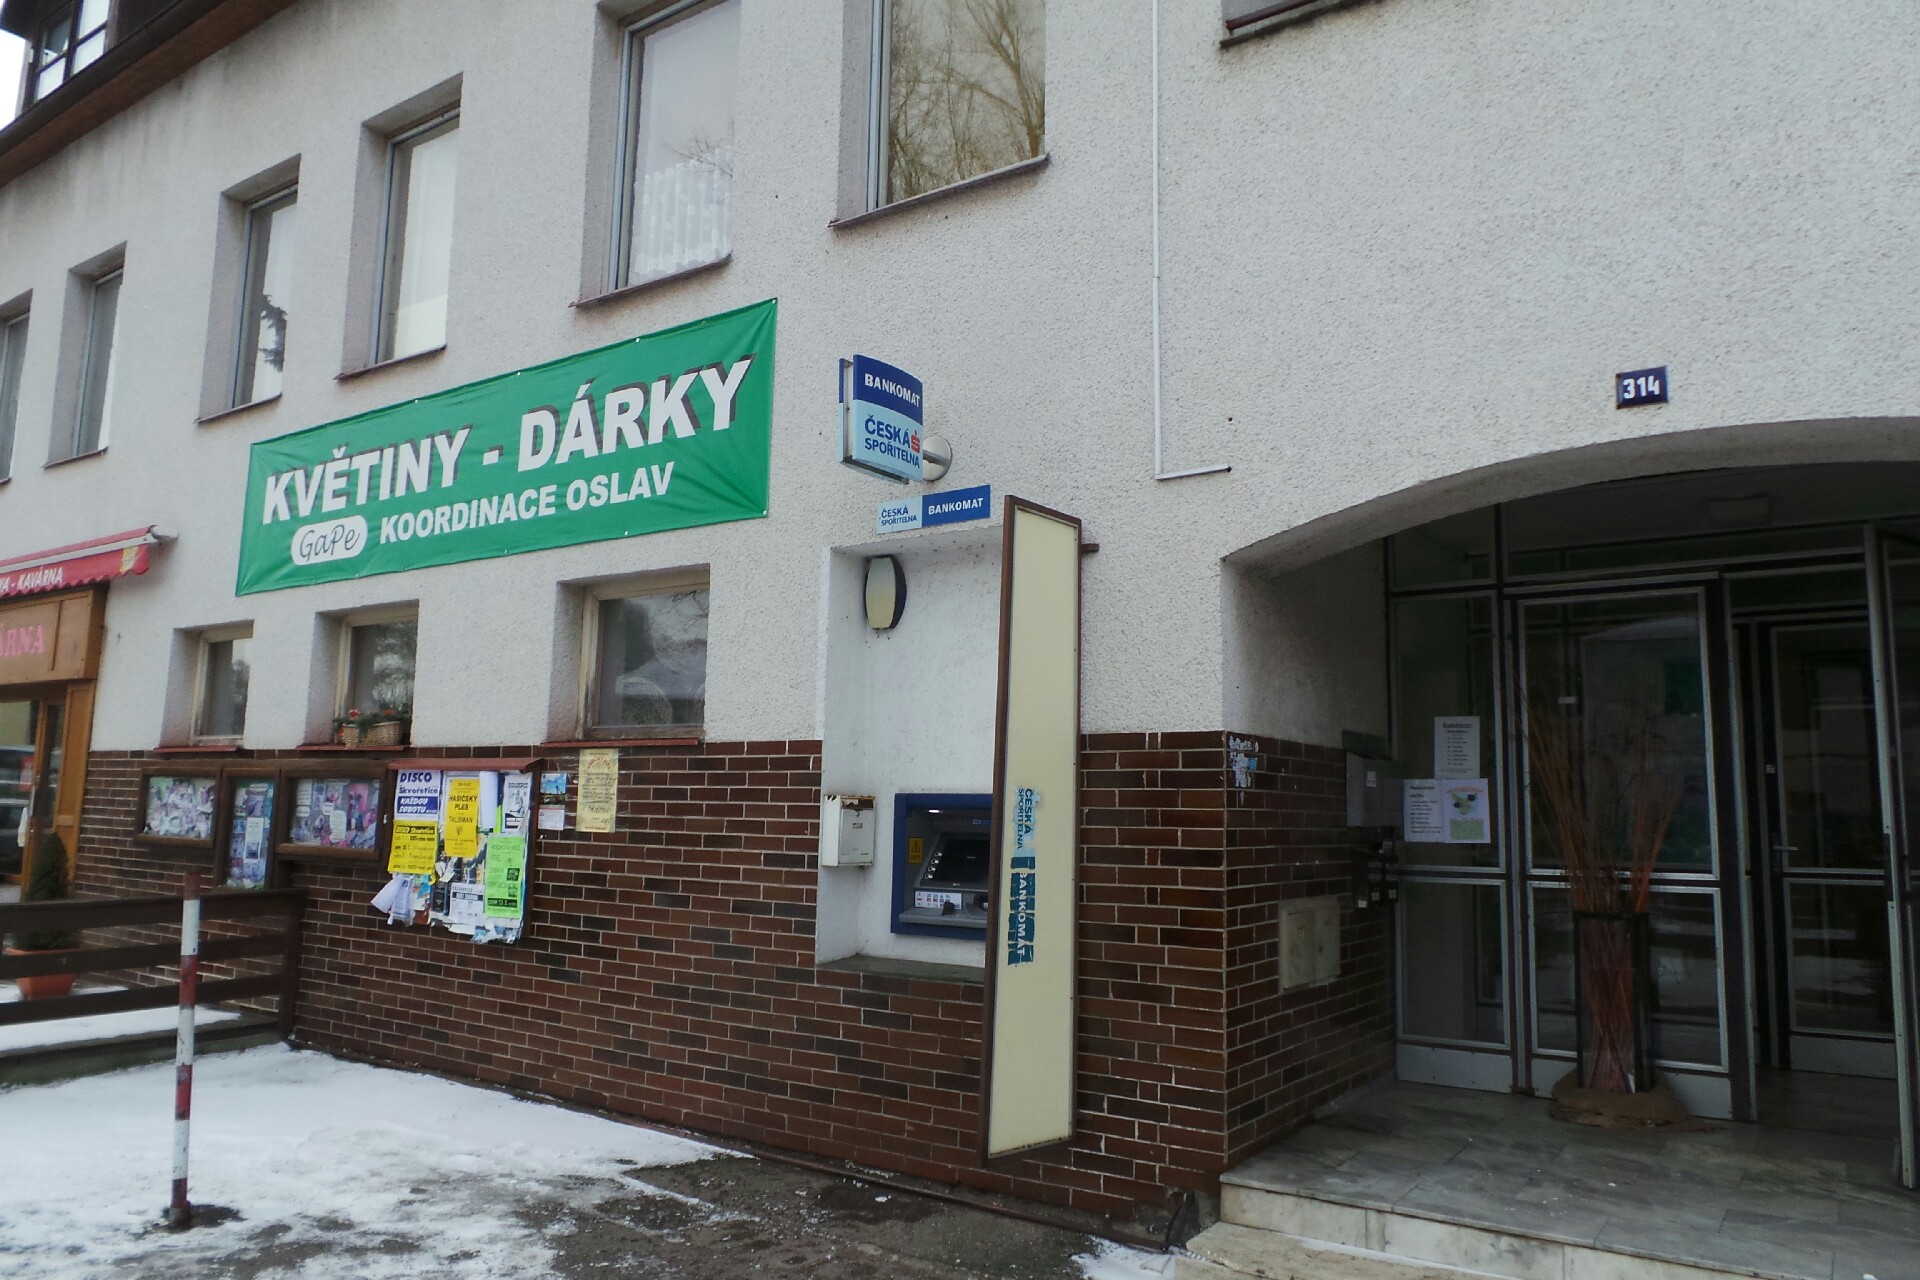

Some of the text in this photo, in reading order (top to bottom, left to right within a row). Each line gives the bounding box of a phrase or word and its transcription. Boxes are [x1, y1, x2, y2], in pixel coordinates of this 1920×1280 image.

[865, 373, 920, 407] BANKOMAT
[1623, 375, 1660, 399] 314
[263, 425, 471, 524] KVĚTINY
[518, 354, 754, 472] DÁRKY
[865, 414, 910, 449] ČESKÁ
[865, 437, 920, 468] SPOŘITELNA
[380, 461, 675, 545] KOORDINACE OSLAV
[881, 504, 909, 518] ČESKÁ
[928, 497, 984, 515] BANKOMAT
[881, 514, 918, 526] SPOŘITELNA
[299, 525, 361, 561] GaPe
[18, 566, 63, 590] KAVÁRNA
[400, 772, 432, 783] DISCO
